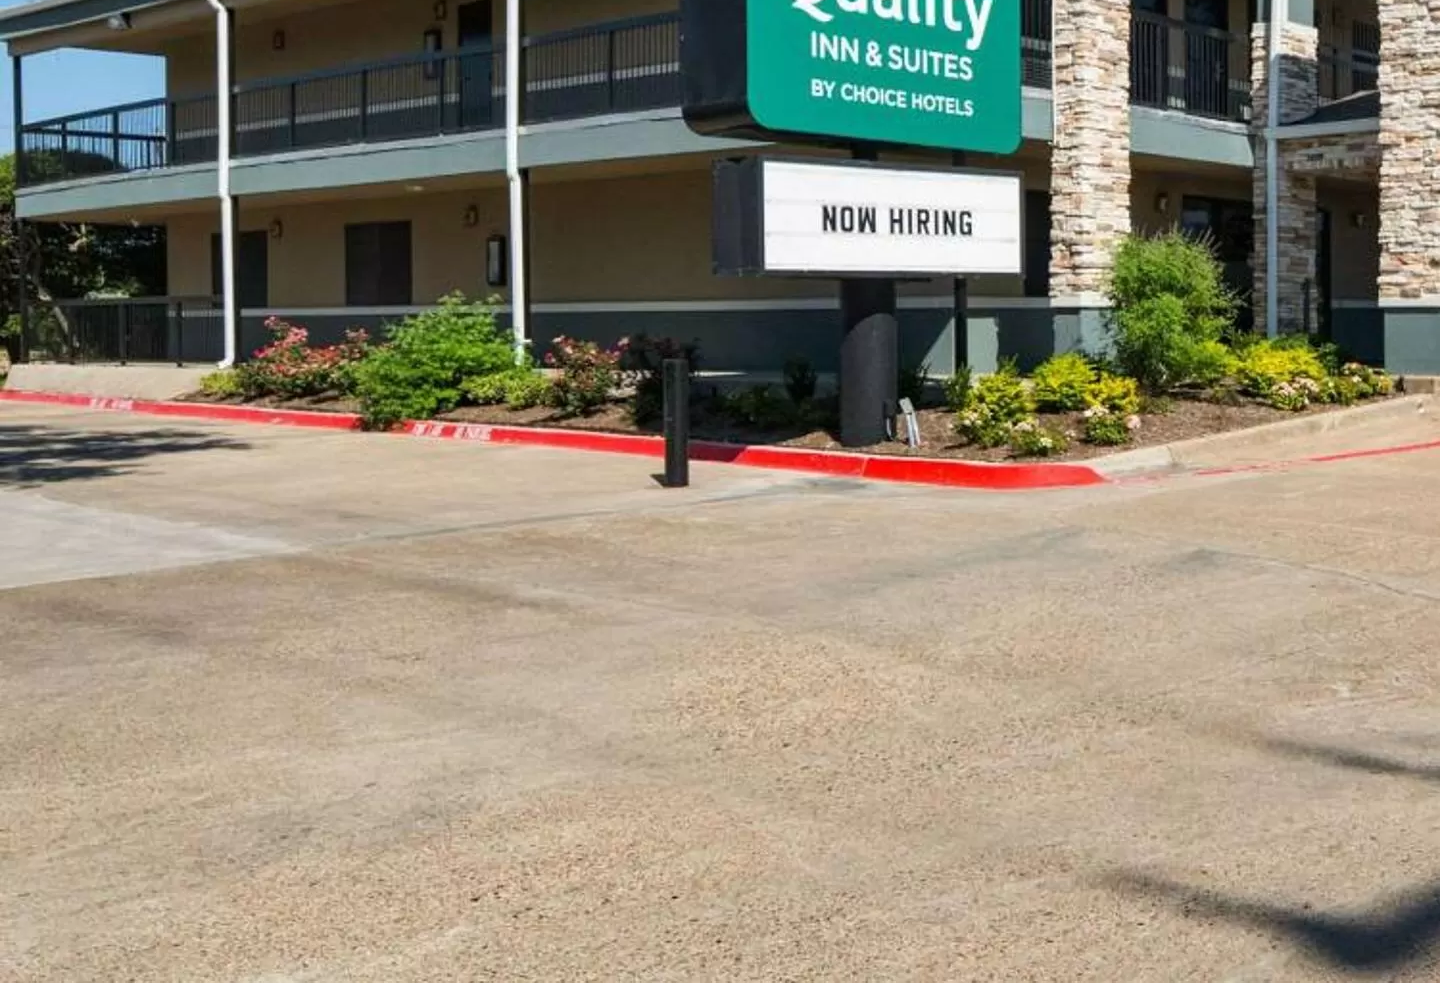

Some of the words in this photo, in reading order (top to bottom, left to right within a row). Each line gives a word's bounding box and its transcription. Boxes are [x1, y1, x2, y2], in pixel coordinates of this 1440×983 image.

[810, 31, 860, 65] INN
[866, 42, 882, 67] &
[888, 47, 973, 81] SUITES
[810, 78, 836, 98] BY
[841, 84, 906, 109] CHOICE
[912, 92, 974, 117] HOTELS
[821, 206, 877, 235] NOW
[889, 208, 973, 236] HIRING
